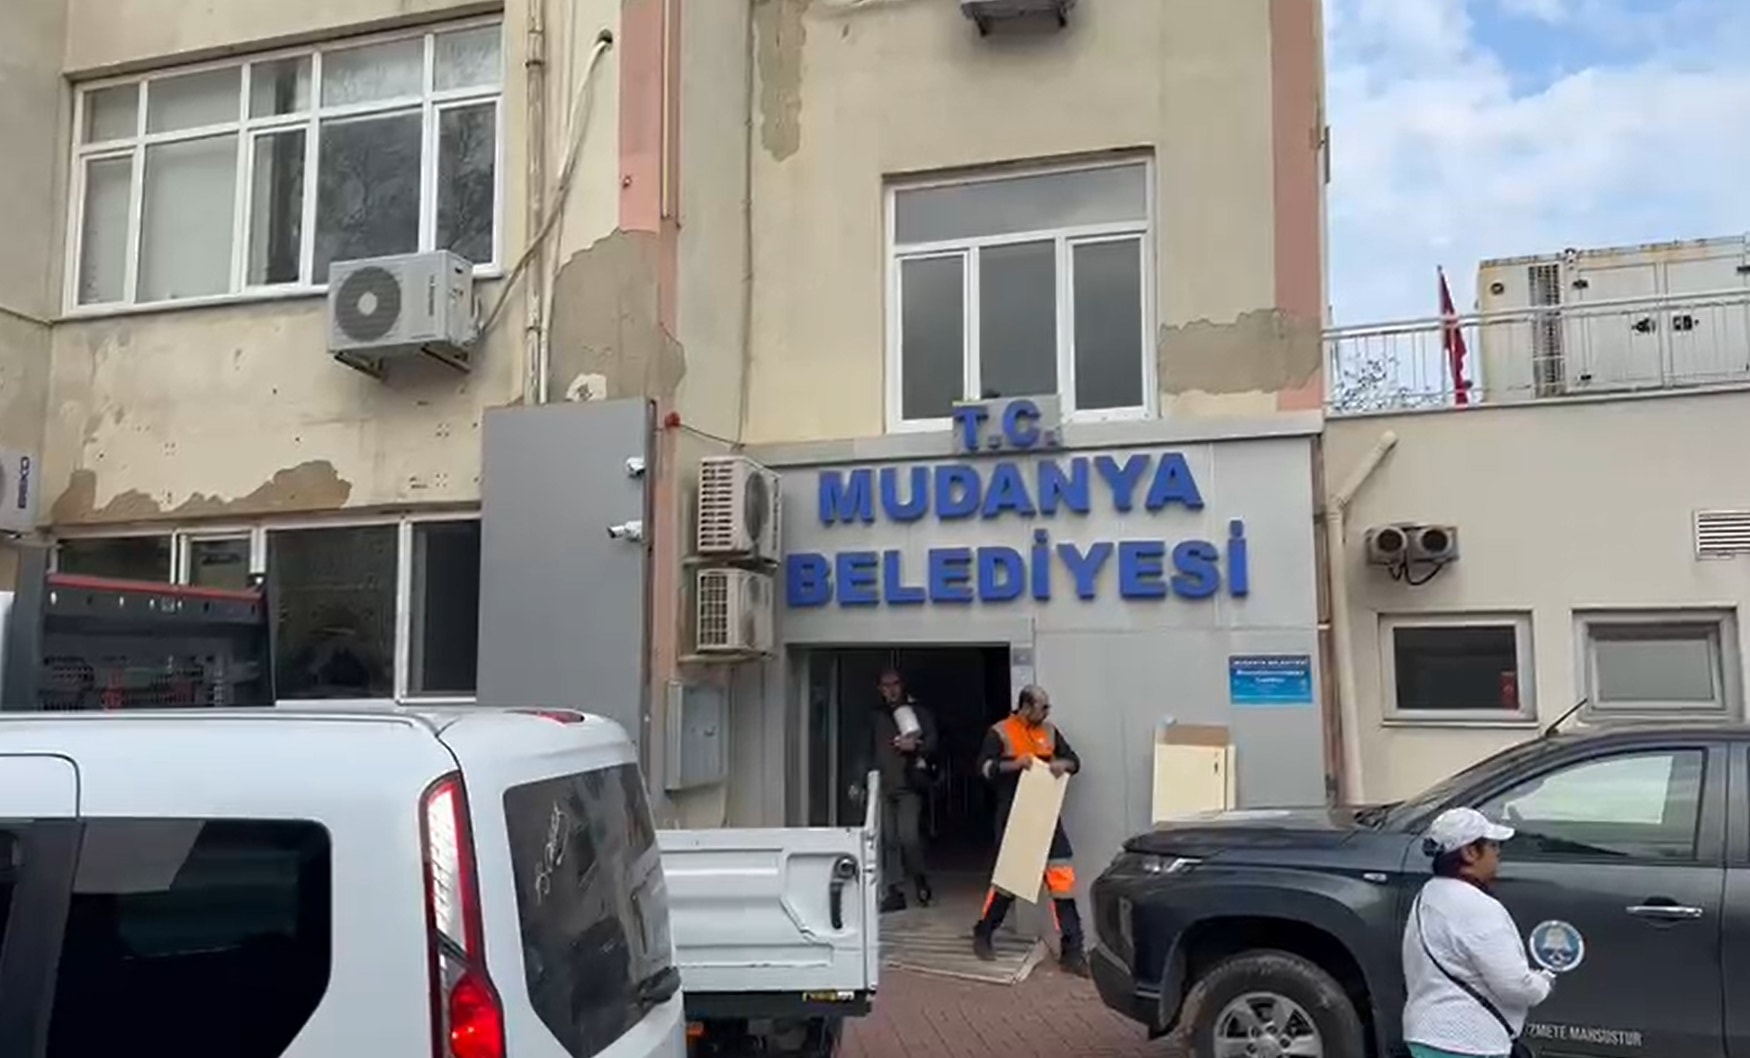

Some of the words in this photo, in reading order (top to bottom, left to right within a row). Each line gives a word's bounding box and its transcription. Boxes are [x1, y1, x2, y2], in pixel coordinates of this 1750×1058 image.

[953, 399, 1060, 451] T.C.
[818, 452, 1204, 525] MUDANYA
[786, 519, 1248, 608] BELEDİYESİ
